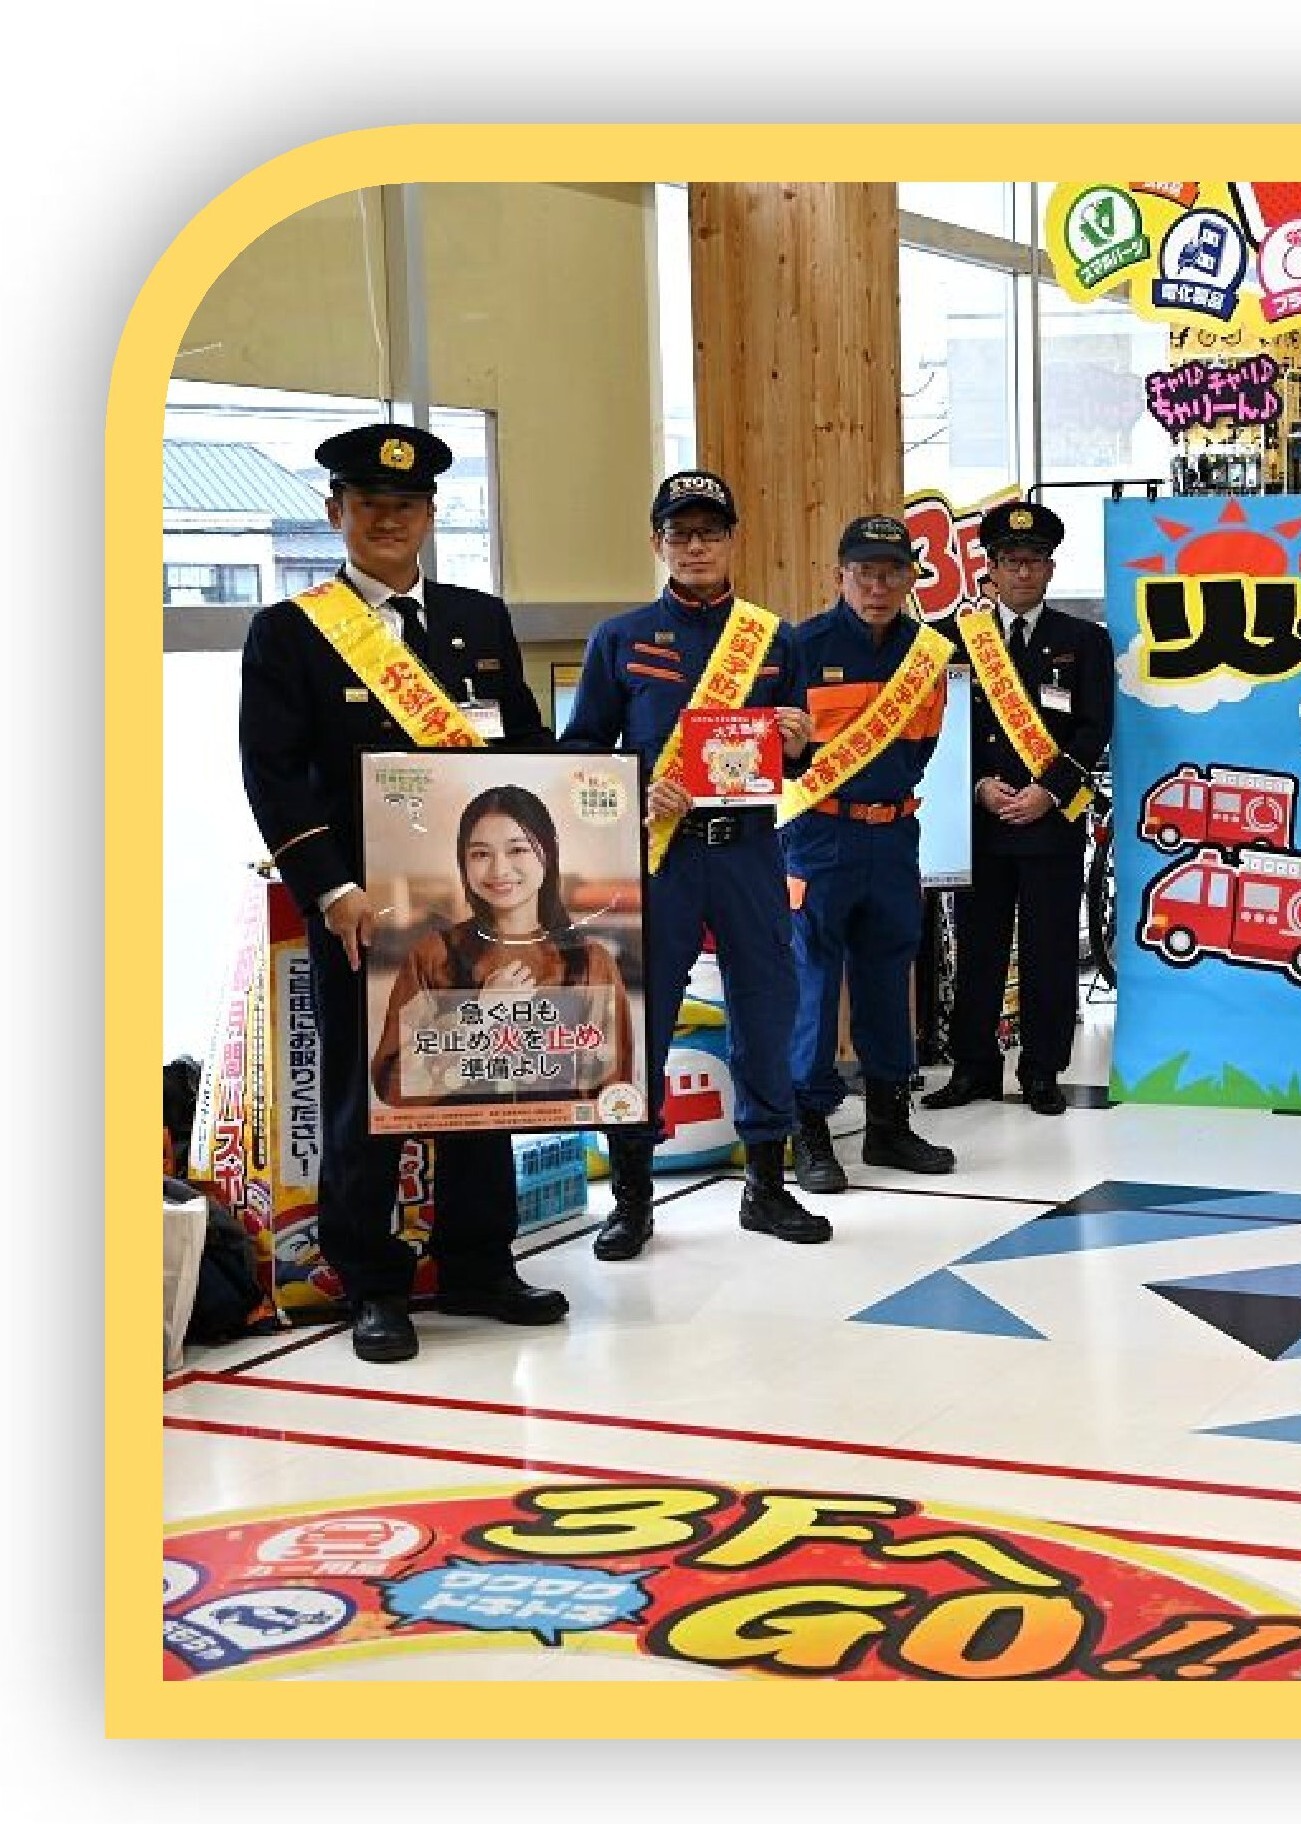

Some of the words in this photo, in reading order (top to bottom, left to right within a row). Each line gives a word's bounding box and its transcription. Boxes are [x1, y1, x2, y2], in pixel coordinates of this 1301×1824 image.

[459, 1000, 558, 1025] 急ぐ日も
[413, 1024, 603, 1054] 足止め火を止め
[460, 1055, 561, 1081] 準備よし
[440, 1569, 632, 1601] ワクワク
